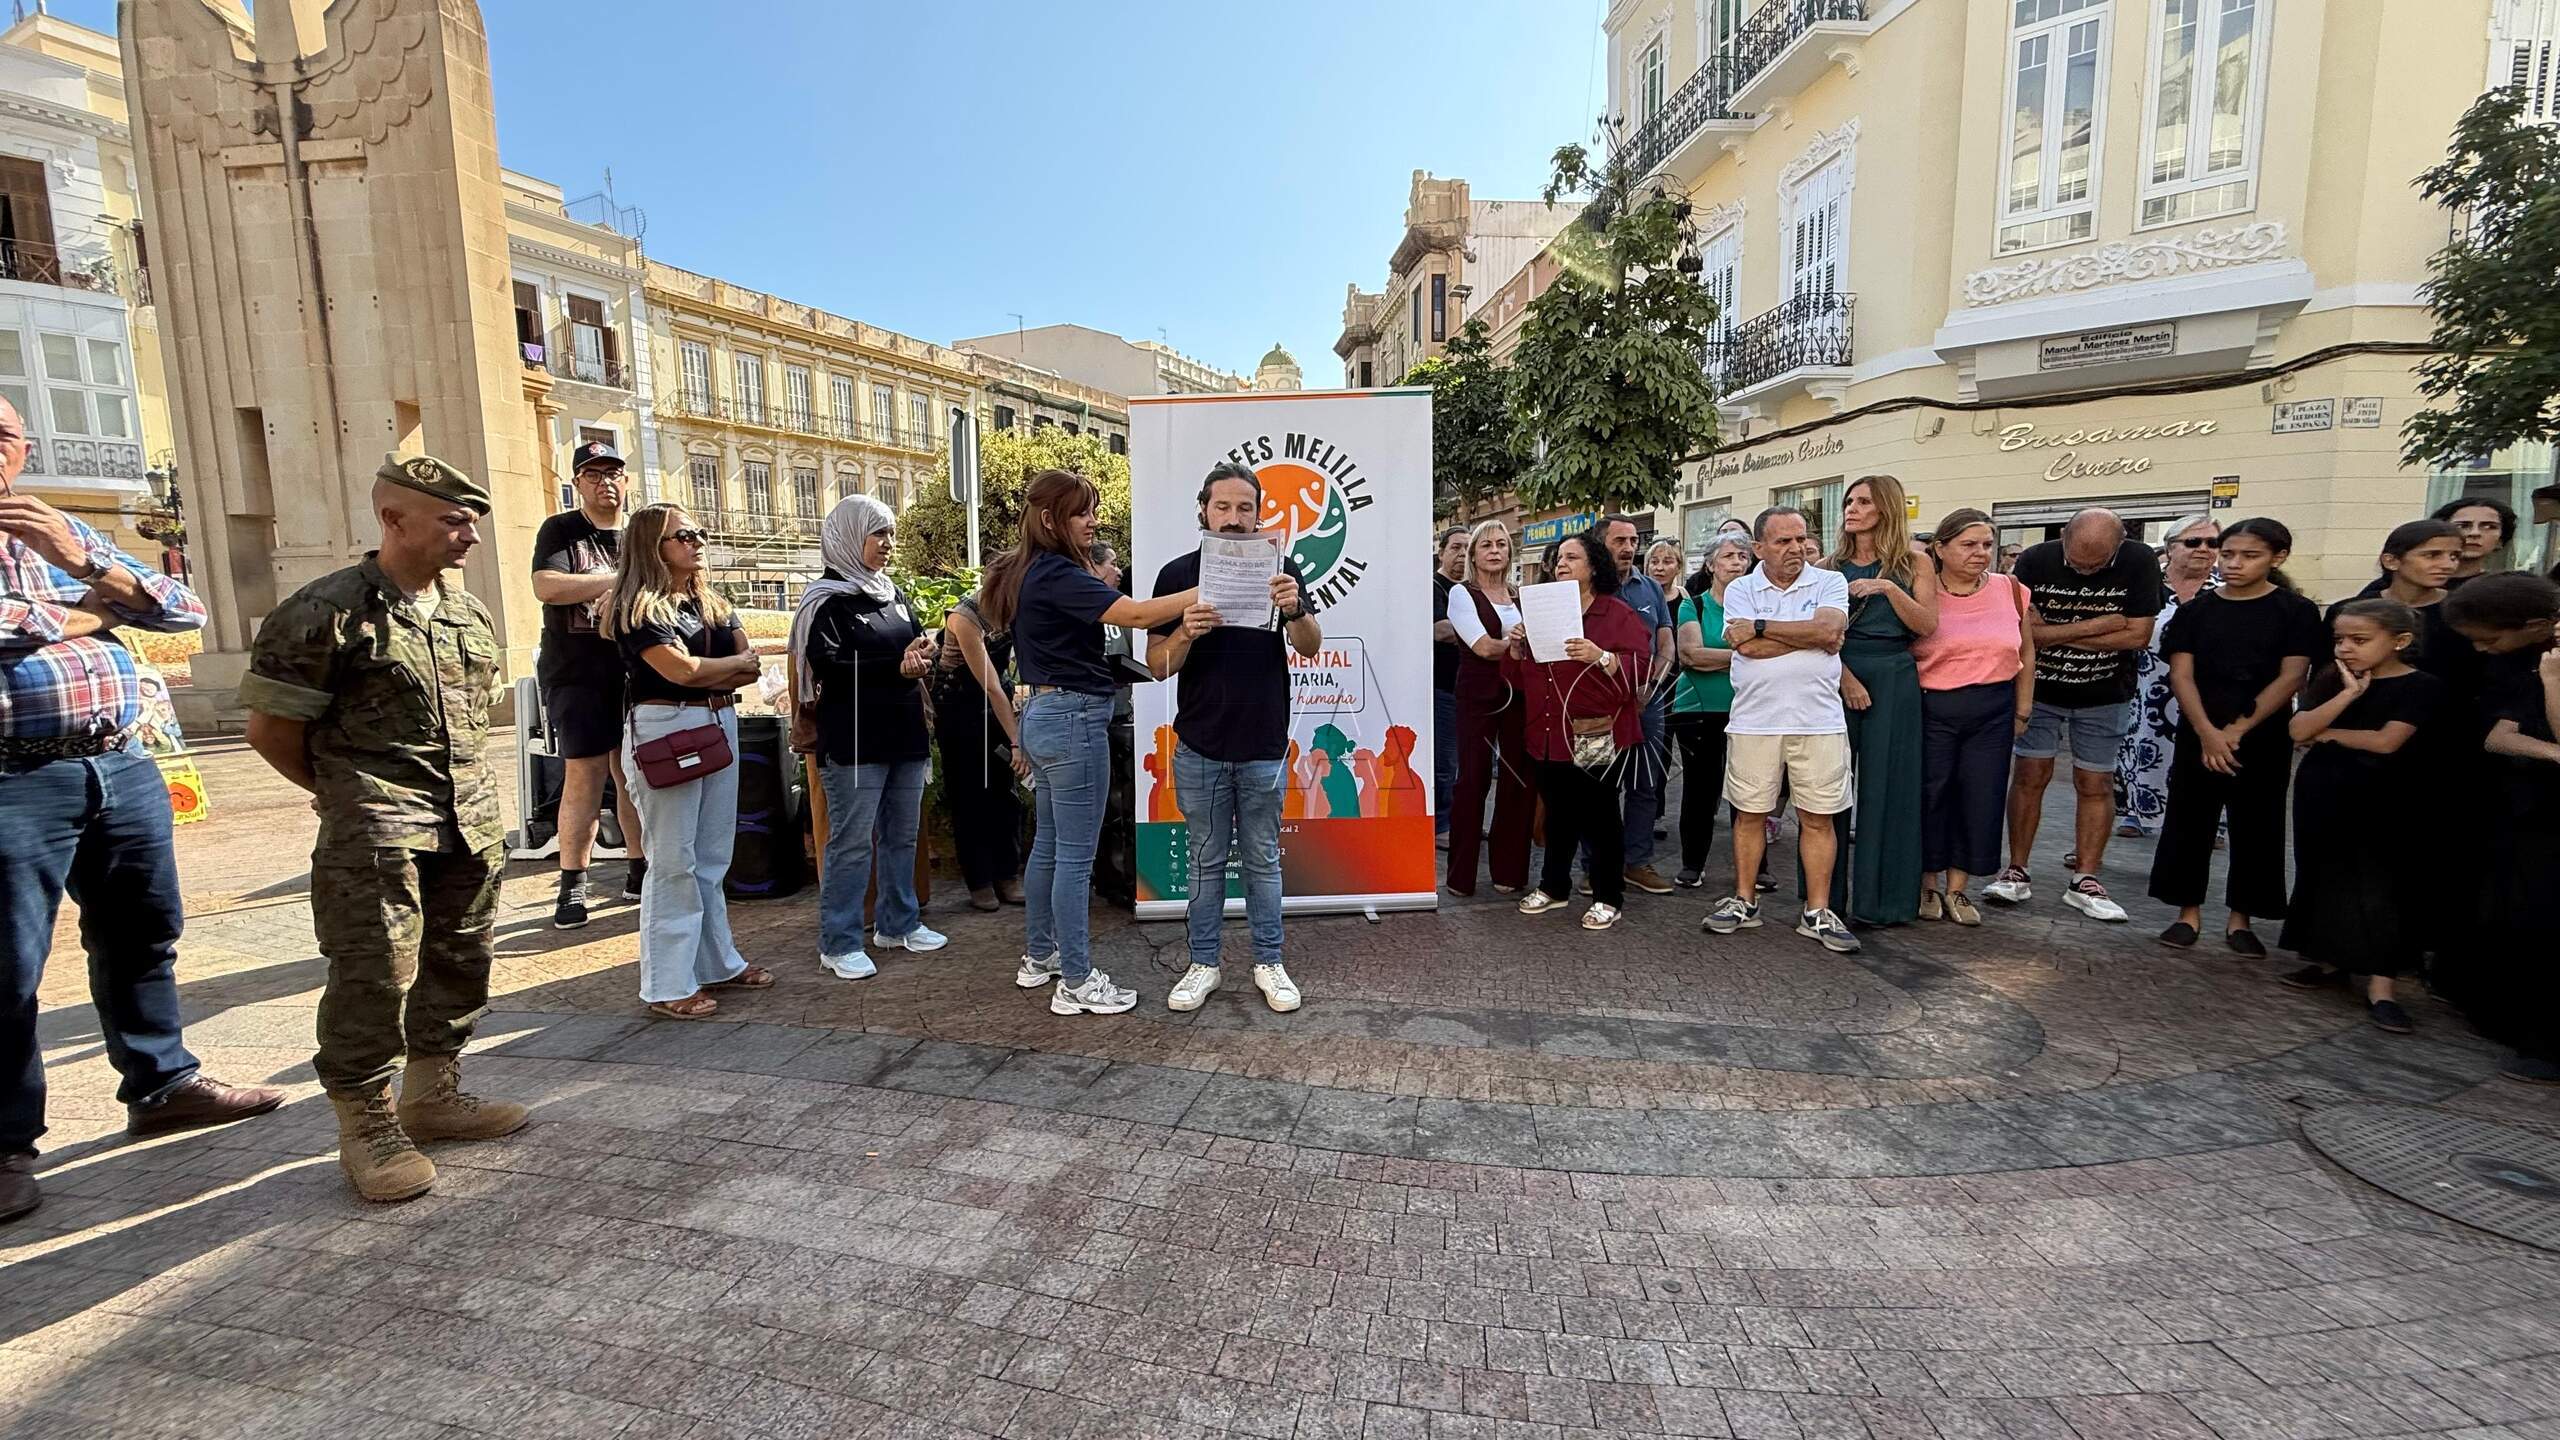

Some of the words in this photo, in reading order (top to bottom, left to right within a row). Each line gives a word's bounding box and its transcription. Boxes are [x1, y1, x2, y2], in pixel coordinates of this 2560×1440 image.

[2045, 344, 2081, 355] Manuel
[2084, 338, 2130, 350] Martínez
[2133, 331, 2170, 344] Martín
[2080, 330, 2133, 342] Edificio
[2298, 403, 2328, 413] PLAZA
[2290, 419, 2328, 430] ESPAÑA
[1799, 432, 1845, 461] Centro
[1284, 432, 1375, 512] MELILLA
[2043, 451, 2152, 482] Centro
[1307, 556, 1368, 615] ENTAL
[1296, 687, 1357, 706] humana
